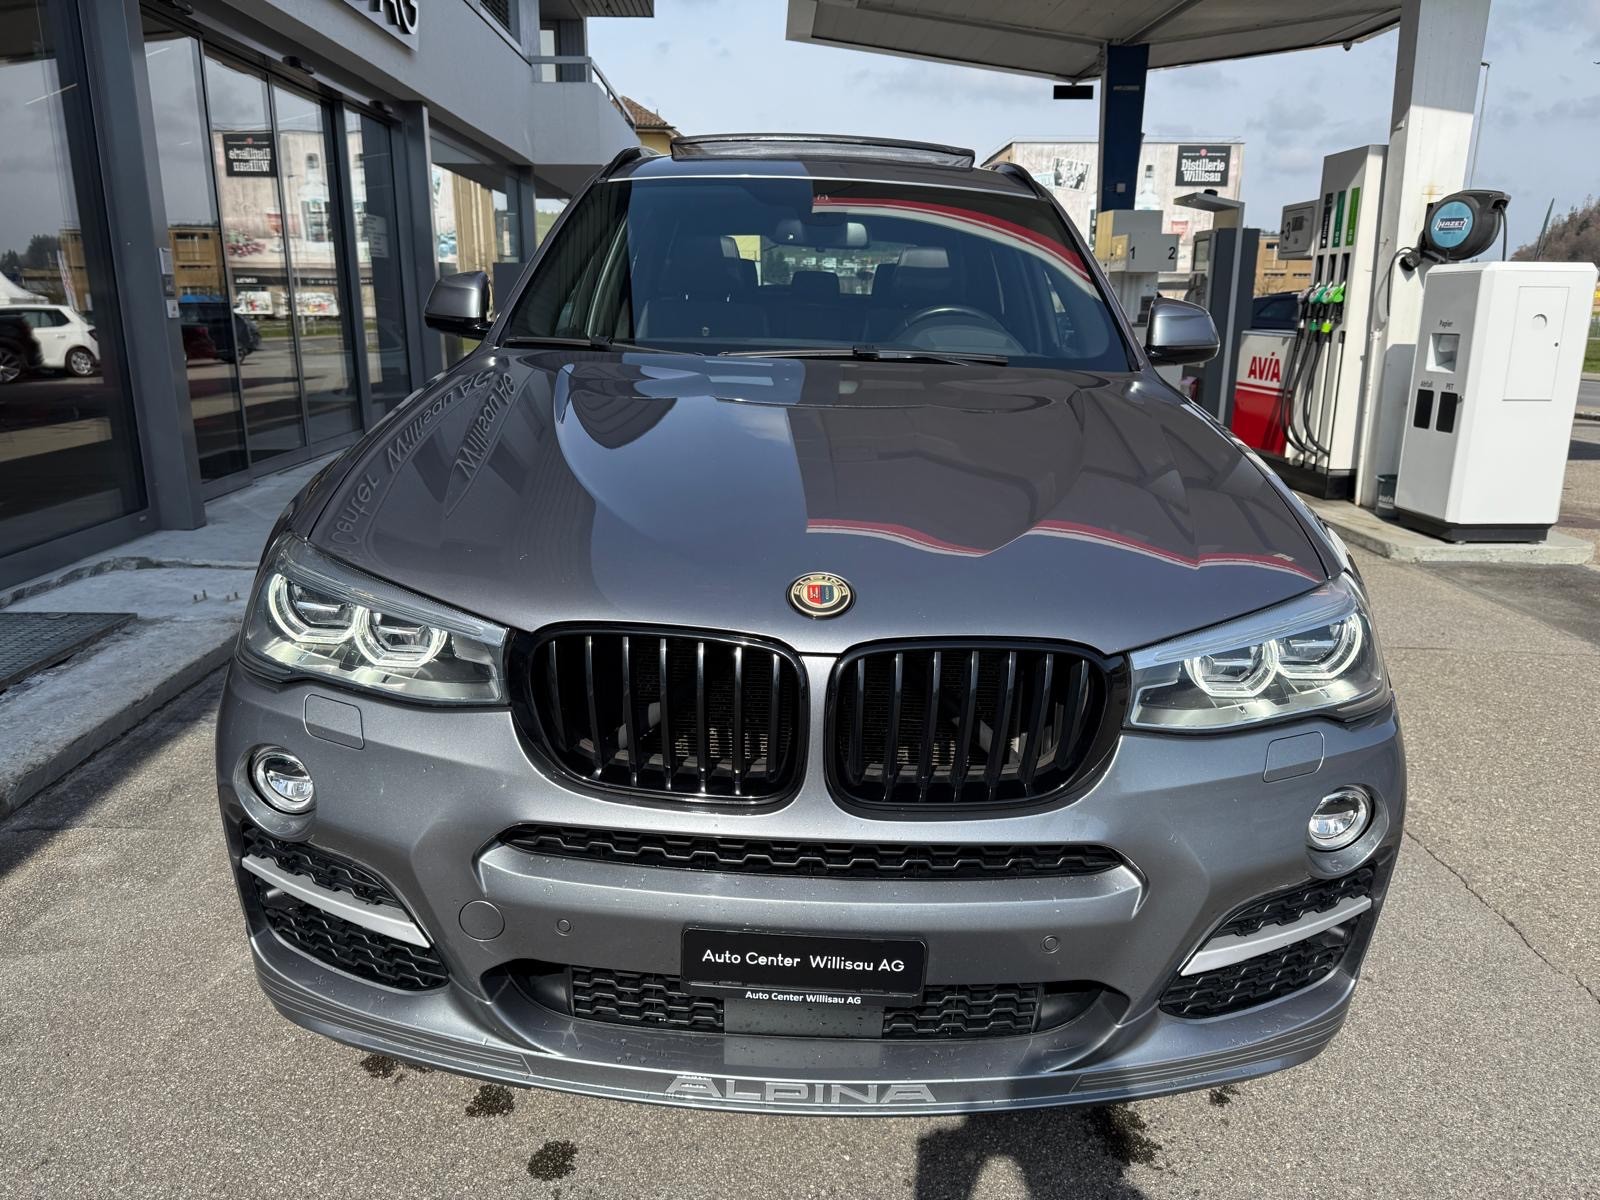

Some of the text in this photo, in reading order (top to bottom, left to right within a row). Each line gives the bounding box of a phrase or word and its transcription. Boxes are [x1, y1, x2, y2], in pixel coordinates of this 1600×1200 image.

[1181, 158, 1226, 171] Distillerie
[1183, 170, 1221, 182] Willisau
[1285, 221, 1291, 242] 3
[1130, 246, 1136, 260] 1
[1168, 246, 1177, 260] 2
[702, 949, 905, 973] Auto Center Willisau AG
[745, 990, 862, 1005] Auto Center Willisau AG
[664, 1075, 937, 1104] ALPINA
